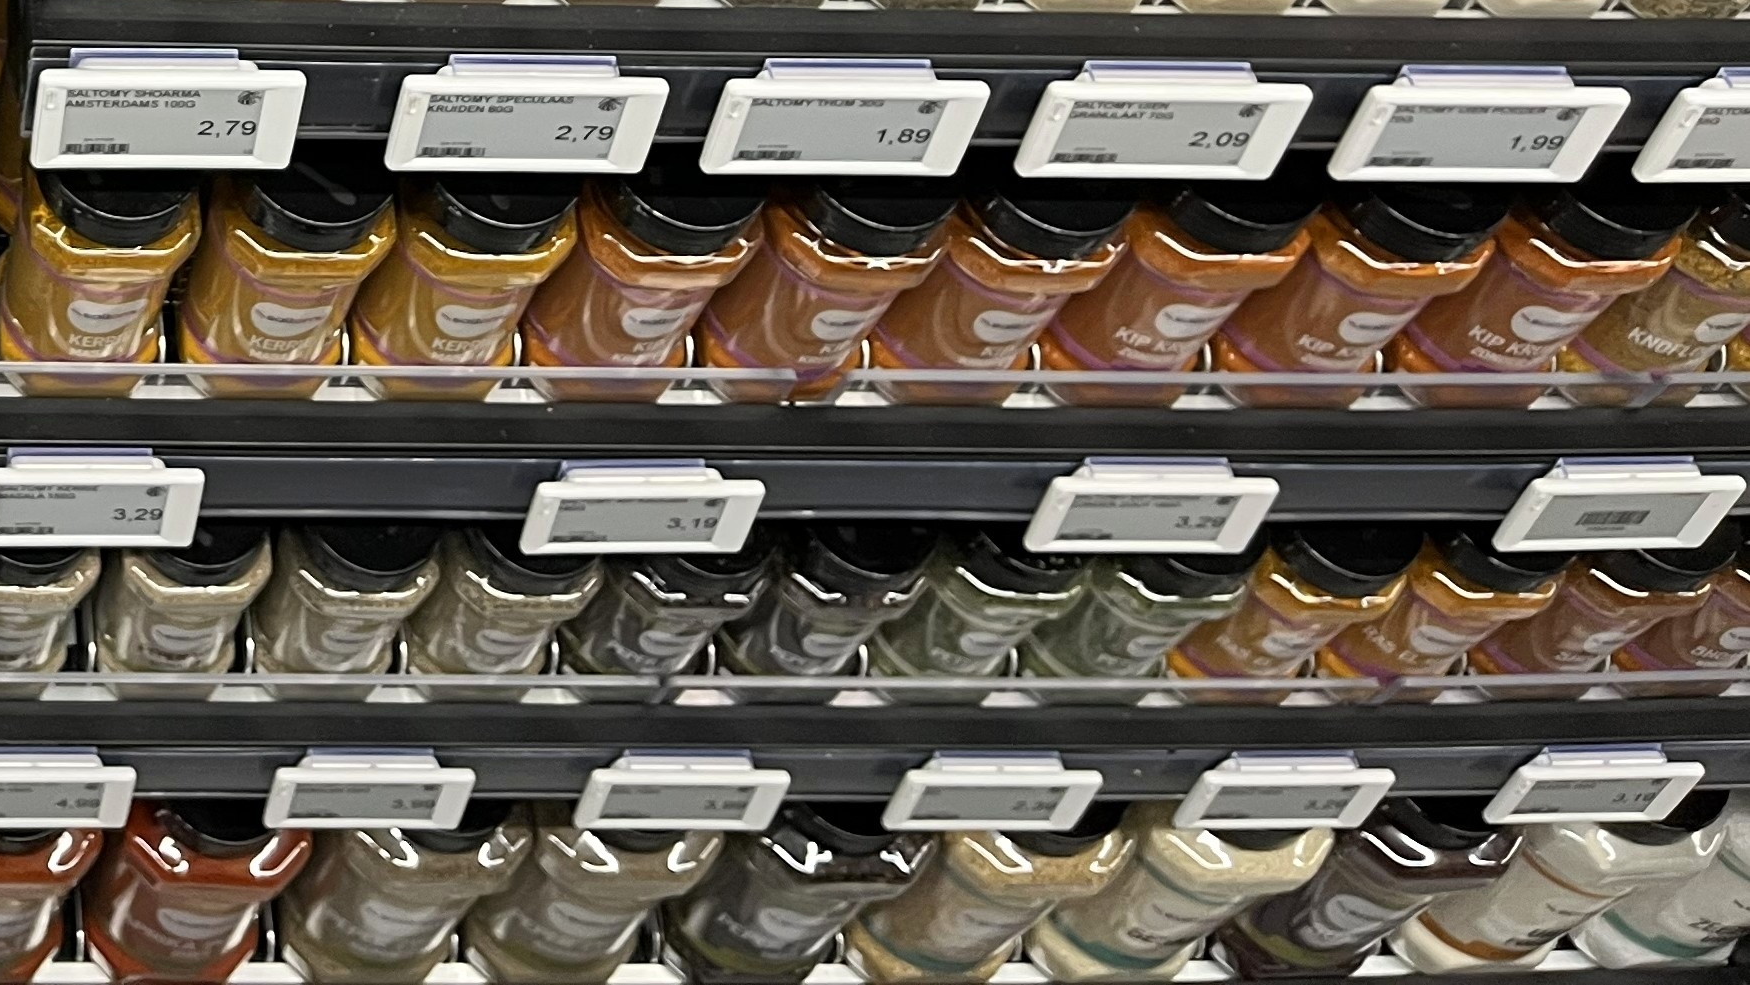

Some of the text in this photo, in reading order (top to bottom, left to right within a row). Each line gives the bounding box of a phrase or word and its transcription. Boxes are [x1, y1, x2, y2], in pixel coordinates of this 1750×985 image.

[197, 120, 257, 138] 2,79
[555, 125, 614, 142] 2,79
[876, 128, 930, 145] 1,89
[1188, 131, 1249, 149] 2,09
[1510, 135, 1563, 152] 1,99
[113, 508, 163, 522] 3,29
